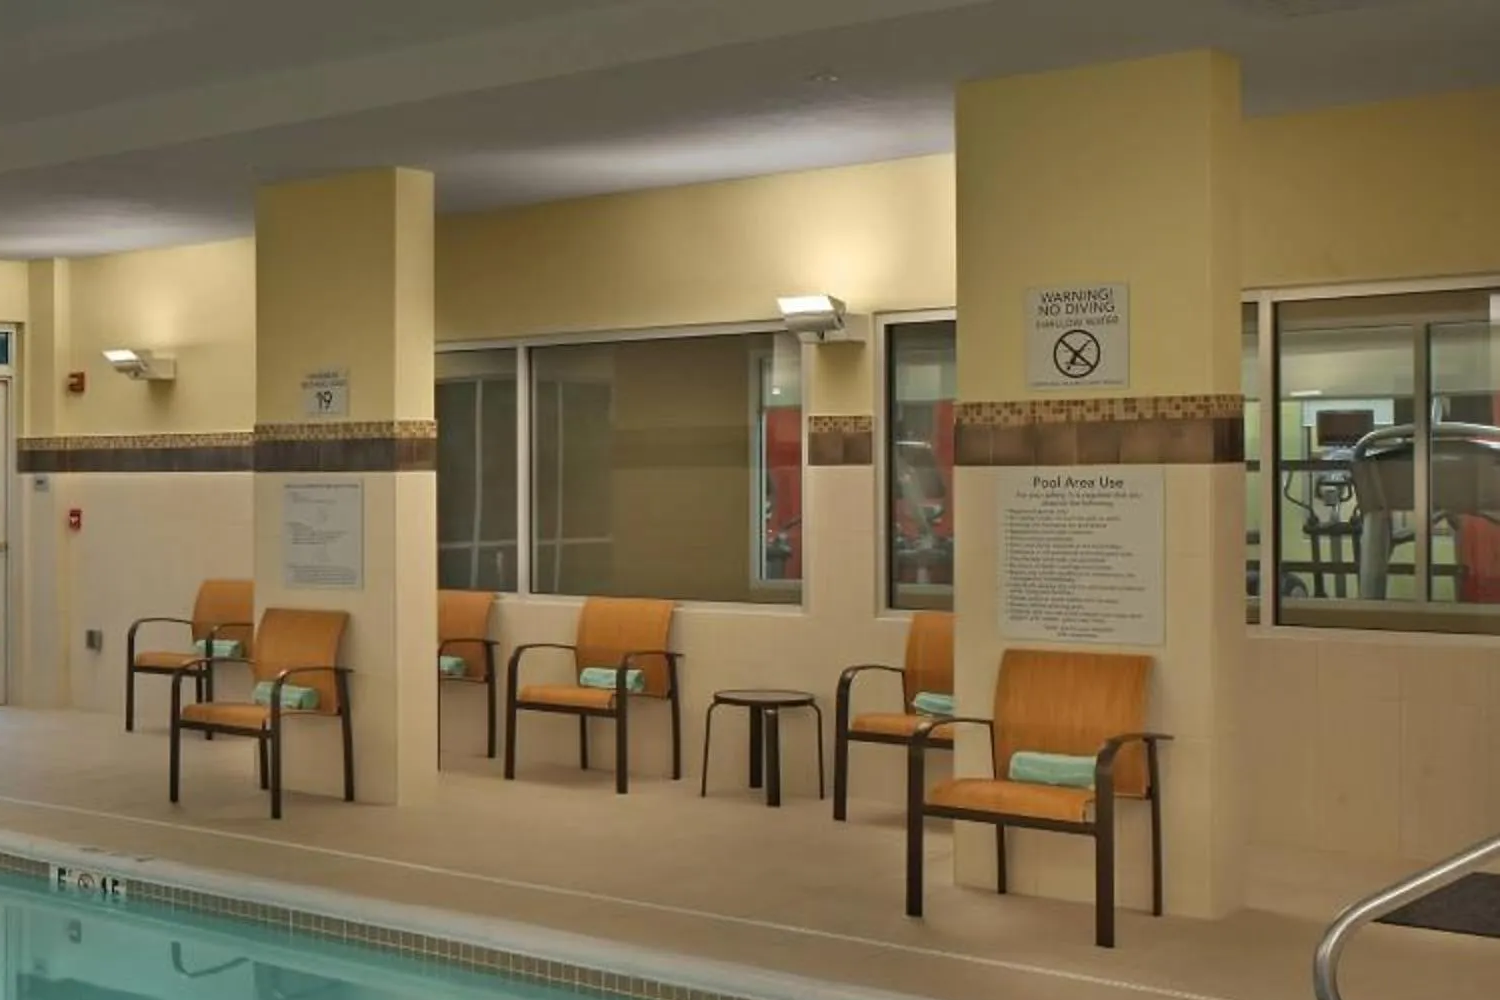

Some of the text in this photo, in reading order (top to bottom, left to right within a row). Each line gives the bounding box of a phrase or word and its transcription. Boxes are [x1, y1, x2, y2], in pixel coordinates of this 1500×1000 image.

[1041, 288, 1114, 304] WARNING!
[1037, 301, 1115, 316] NO DIVING
[1032, 476, 1124, 489] Pool Area Use
